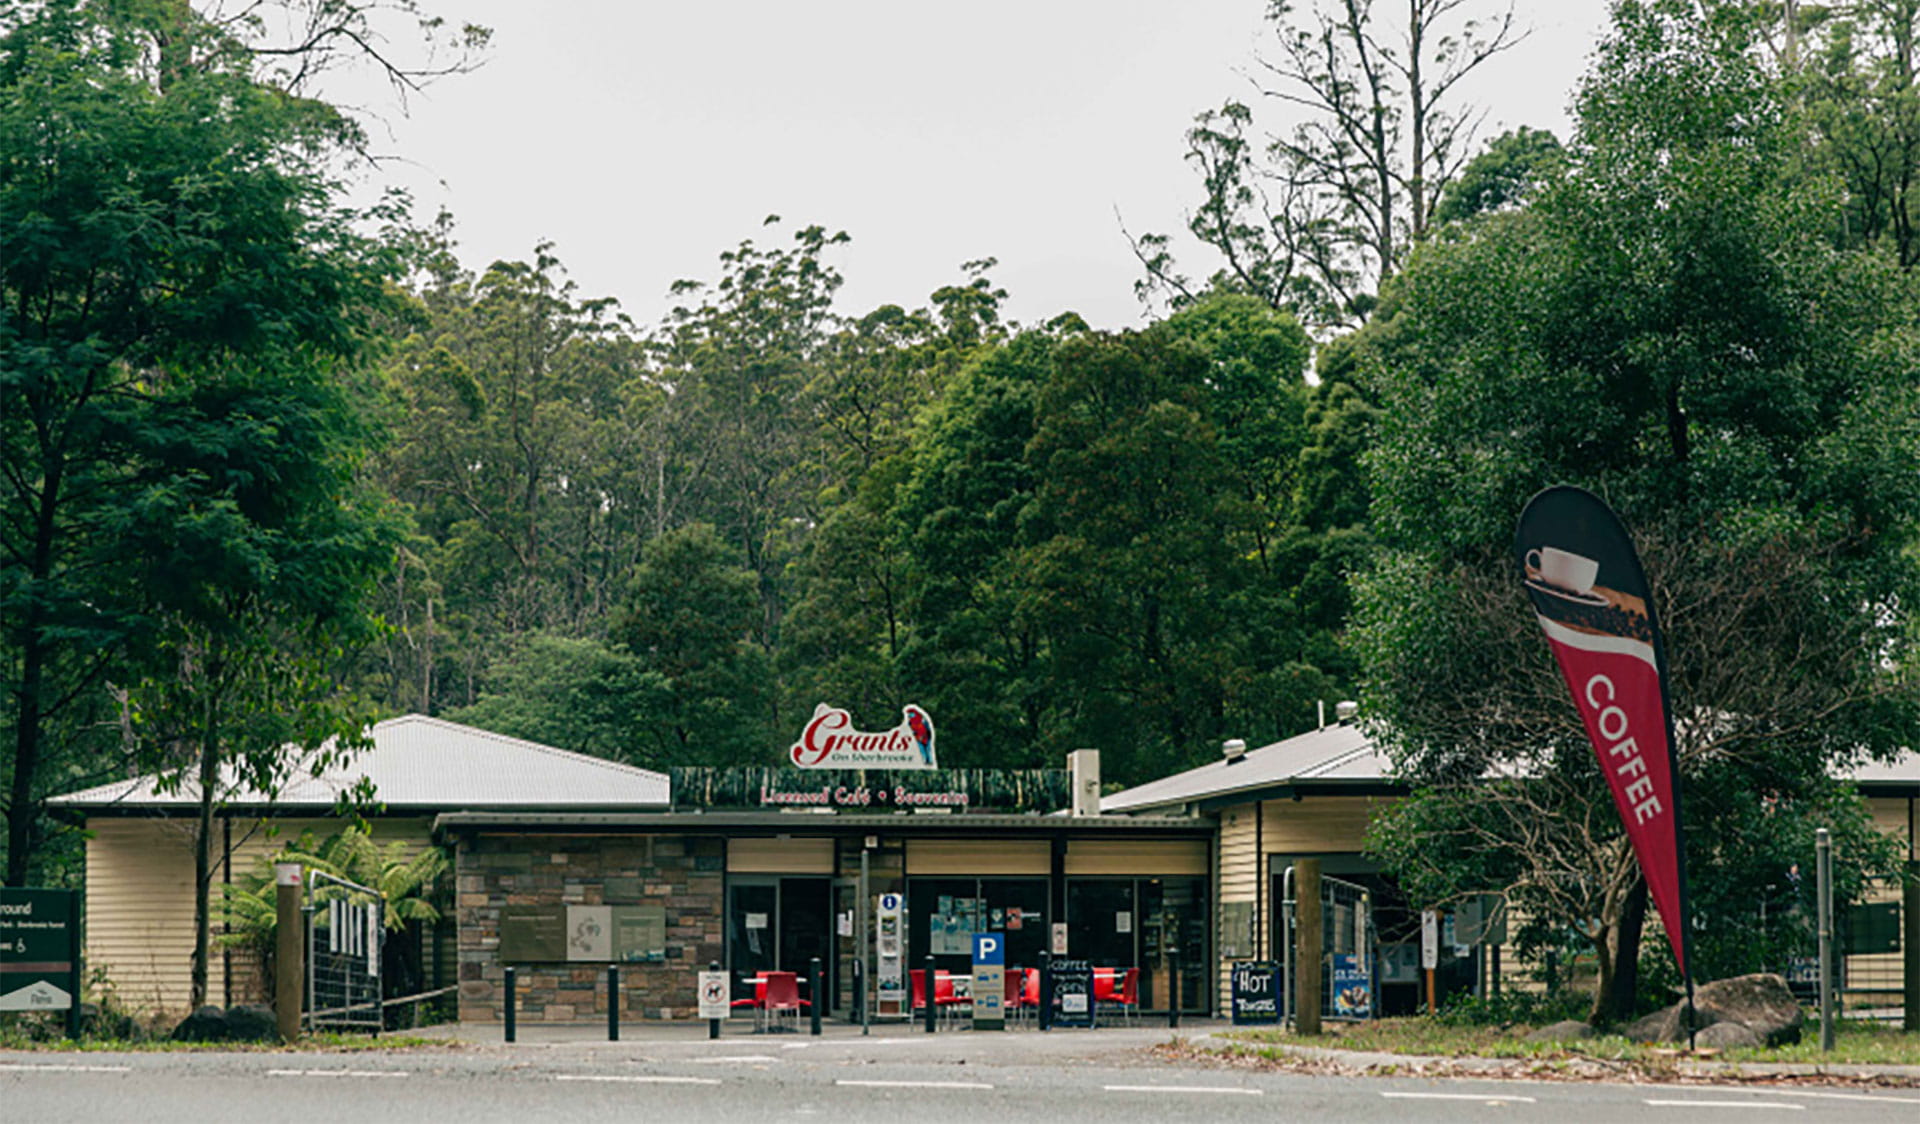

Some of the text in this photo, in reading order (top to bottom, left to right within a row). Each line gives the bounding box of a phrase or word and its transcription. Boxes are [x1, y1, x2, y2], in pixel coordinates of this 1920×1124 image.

[794, 711, 912, 765] Grants
[1586, 674, 1662, 825] COFFEE
[760, 786, 969, 805] Licensed Café Souvenirs
[979, 938, 997, 960] P
[1240, 971, 1272, 993] HOT
